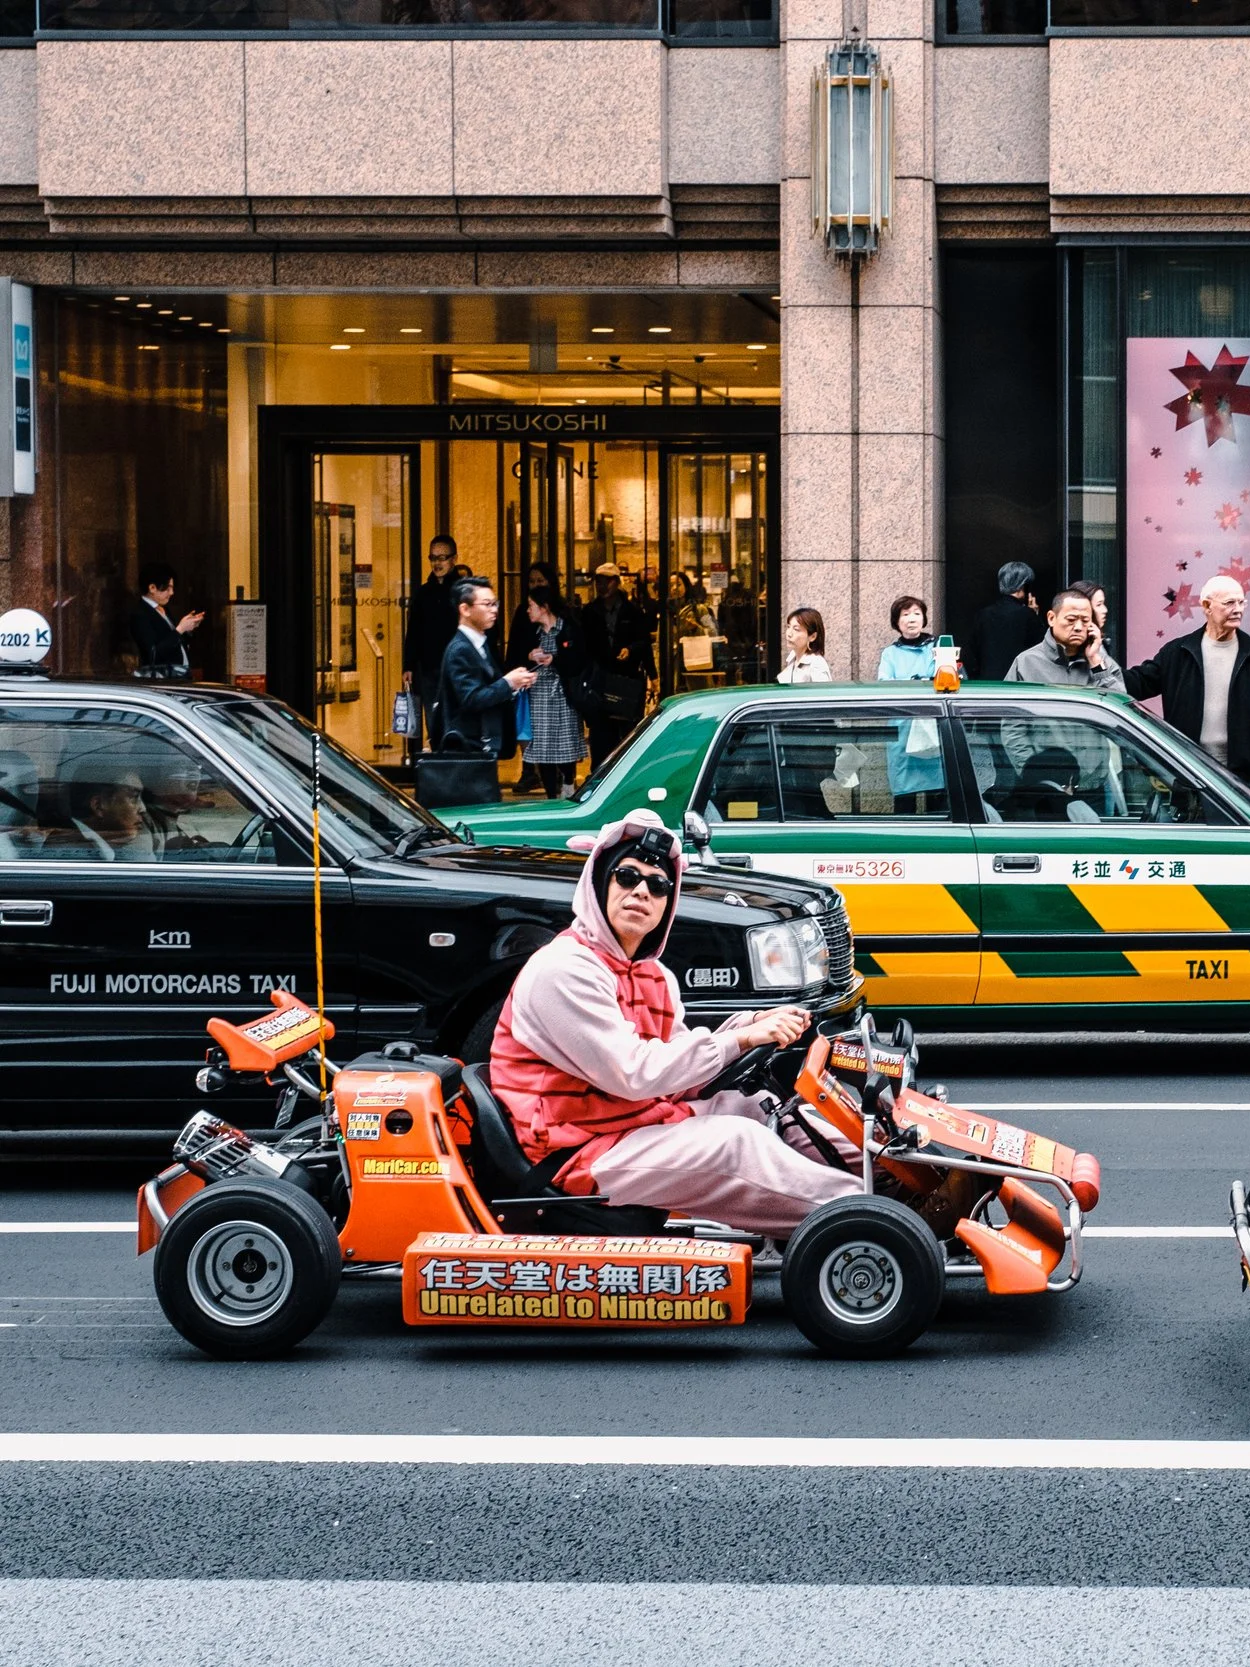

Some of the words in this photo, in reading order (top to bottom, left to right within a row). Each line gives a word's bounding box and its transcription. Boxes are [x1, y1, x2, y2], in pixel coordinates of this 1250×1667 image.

[450, 414, 607, 431] MITSUKOSHI
[0, 634, 30, 647] 2202
[855, 861, 903, 877] 5326
[1072, 860, 1111, 879] 杉並
[1148, 860, 1187, 879] 交通
[1186, 960, 1228, 979] TAXI
[50, 974, 96, 993] FUJI
[106, 974, 241, 994] MOTORCARS
[249, 975, 296, 993] TAXI
[363, 1159, 450, 1175] MariCar.com
[421, 1259, 730, 1295] 任天堂は無関係
[420, 1290, 560, 1318] Unrelated
[564, 1294, 595, 1319] to
[600, 1296, 731, 1321] Nintendo
